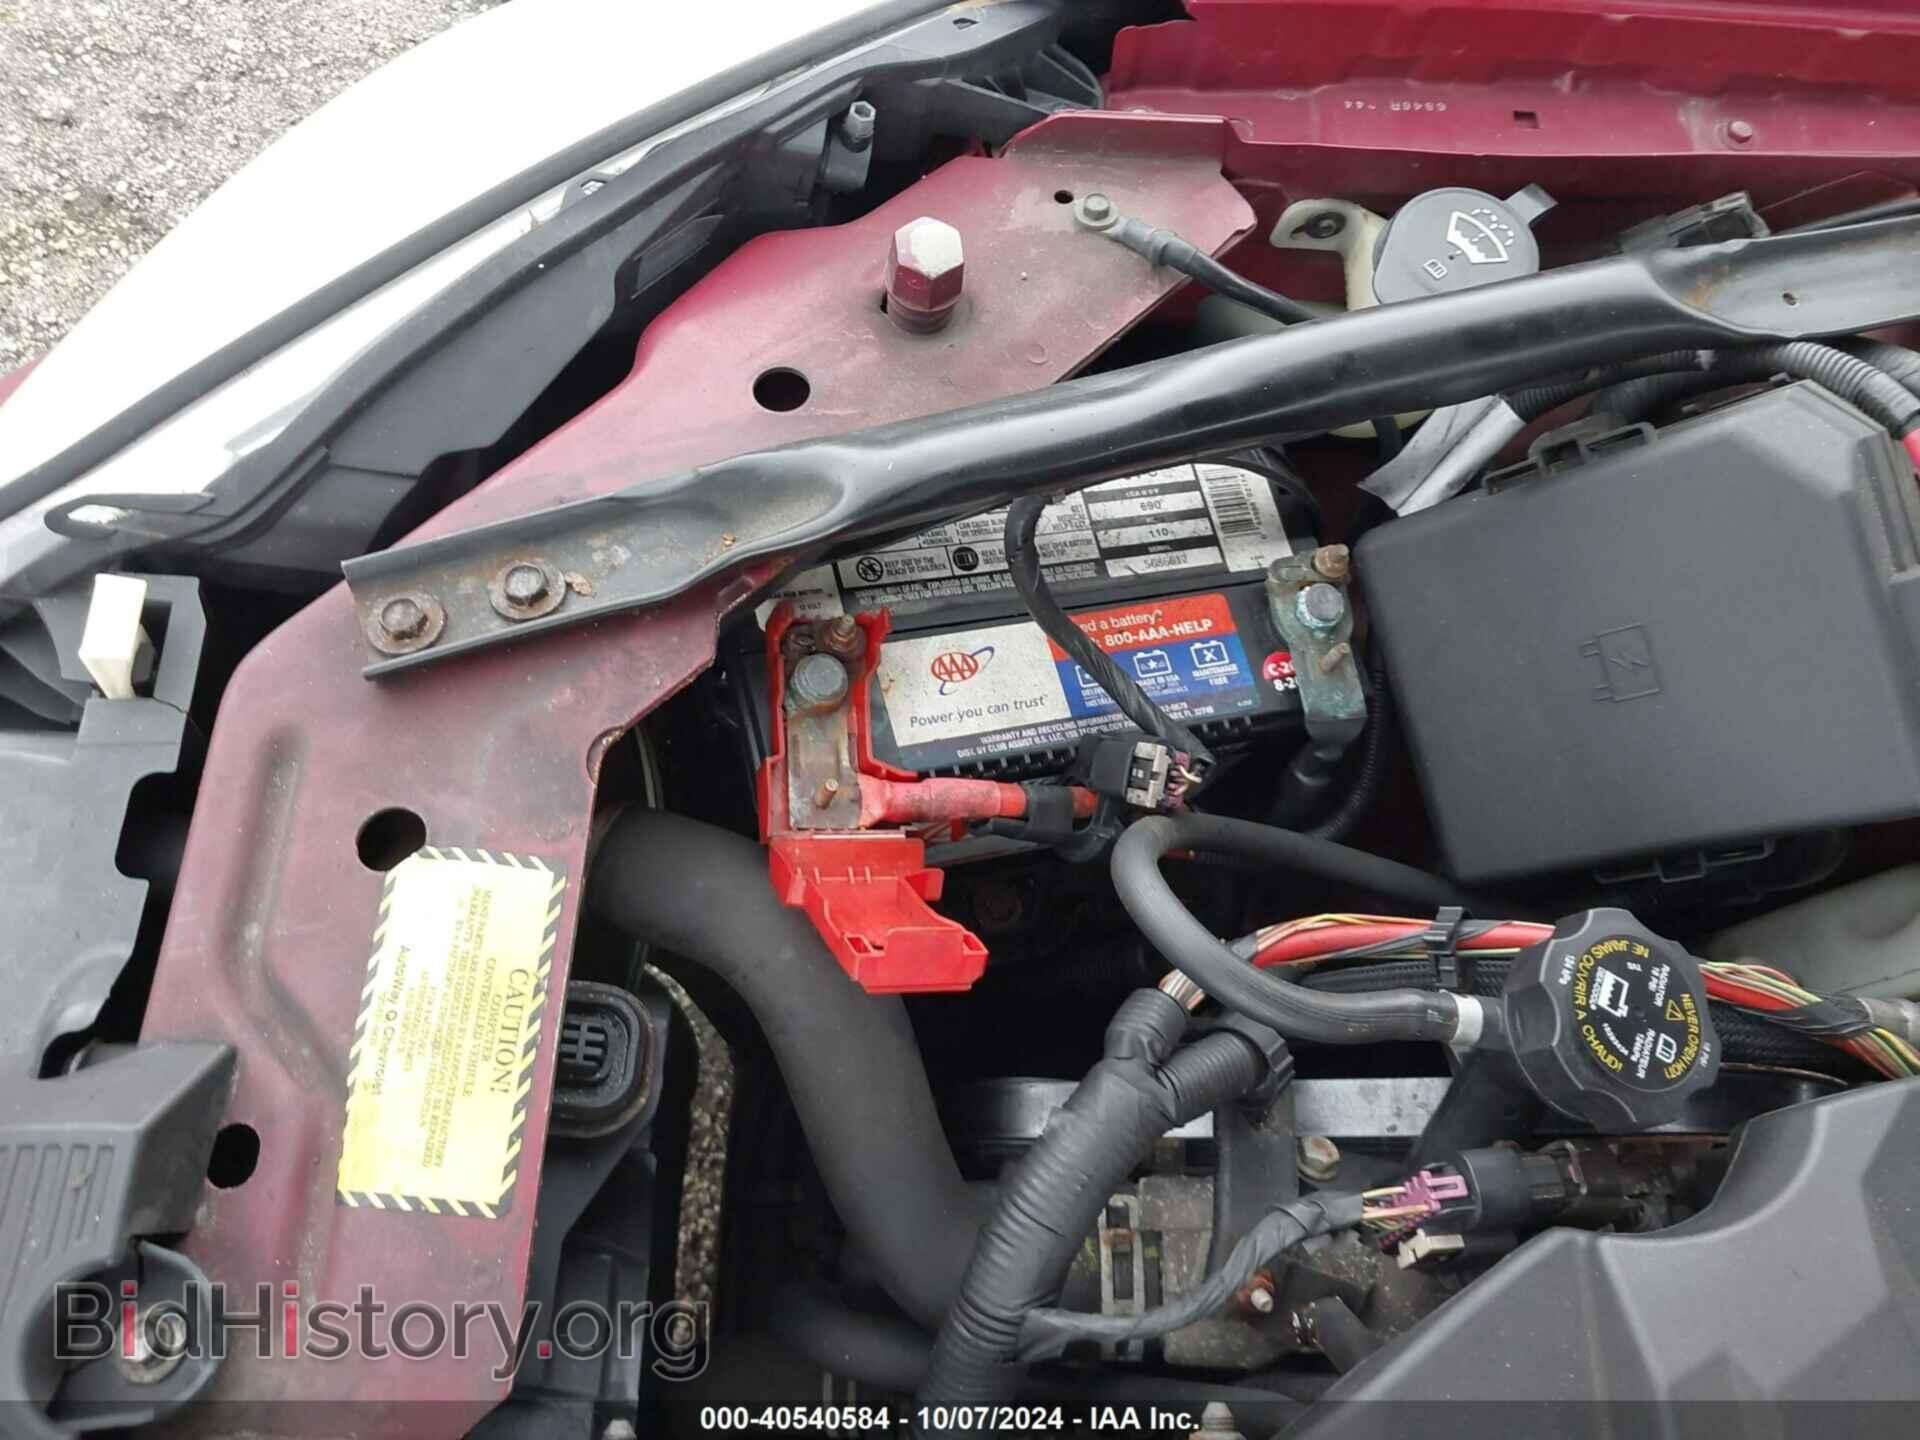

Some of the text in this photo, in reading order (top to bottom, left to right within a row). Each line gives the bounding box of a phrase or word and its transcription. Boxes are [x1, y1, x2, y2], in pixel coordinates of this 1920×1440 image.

[1140, 500, 1161, 511] 690
[1149, 527, 1169, 538] 110
[884, 559, 900, 569] KEEP
[901, 558, 912, 567] OUT
[923, 556, 934, 565] THE
[1099, 621, 1109, 630] a
[1110, 609, 1163, 628] battery?
[1104, 618, 1213, 647] 800-AAA-HELP
[934, 652, 976, 682] AAA
[1267, 661, 1295, 677] C-2
[910, 711, 953, 728] Power
[956, 707, 983, 723] you
[987, 702, 1009, 714] can
[980, 731, 1021, 744] WARRANTY
[1022, 727, 1037, 738] AND
[1038, 721, 1076, 736] RECYCLING
[977, 747, 987, 756] BY
[988, 743, 1008, 753] CLUB
[1008, 739, 1033, 751] ASSIST
[1591, 939, 1630, 959] JAMAIS
[385, 944, 409, 1006] AutoWay
[1574, 954, 1595, 1006] OUVRIR
[1653, 963, 1671, 1007] RADIATOR
[471, 957, 496, 1040] CONTROLLED
[1575, 1009, 1587, 1020] A
[1680, 993, 1699, 1034] NEVER
[489, 966, 529, 1094] CAUTION!
[370, 1025, 395, 1096] Chevrolet
[1635, 1028, 1656, 1079] RADIATEUR
[1681, 1034, 1699, 1066] OPEN
